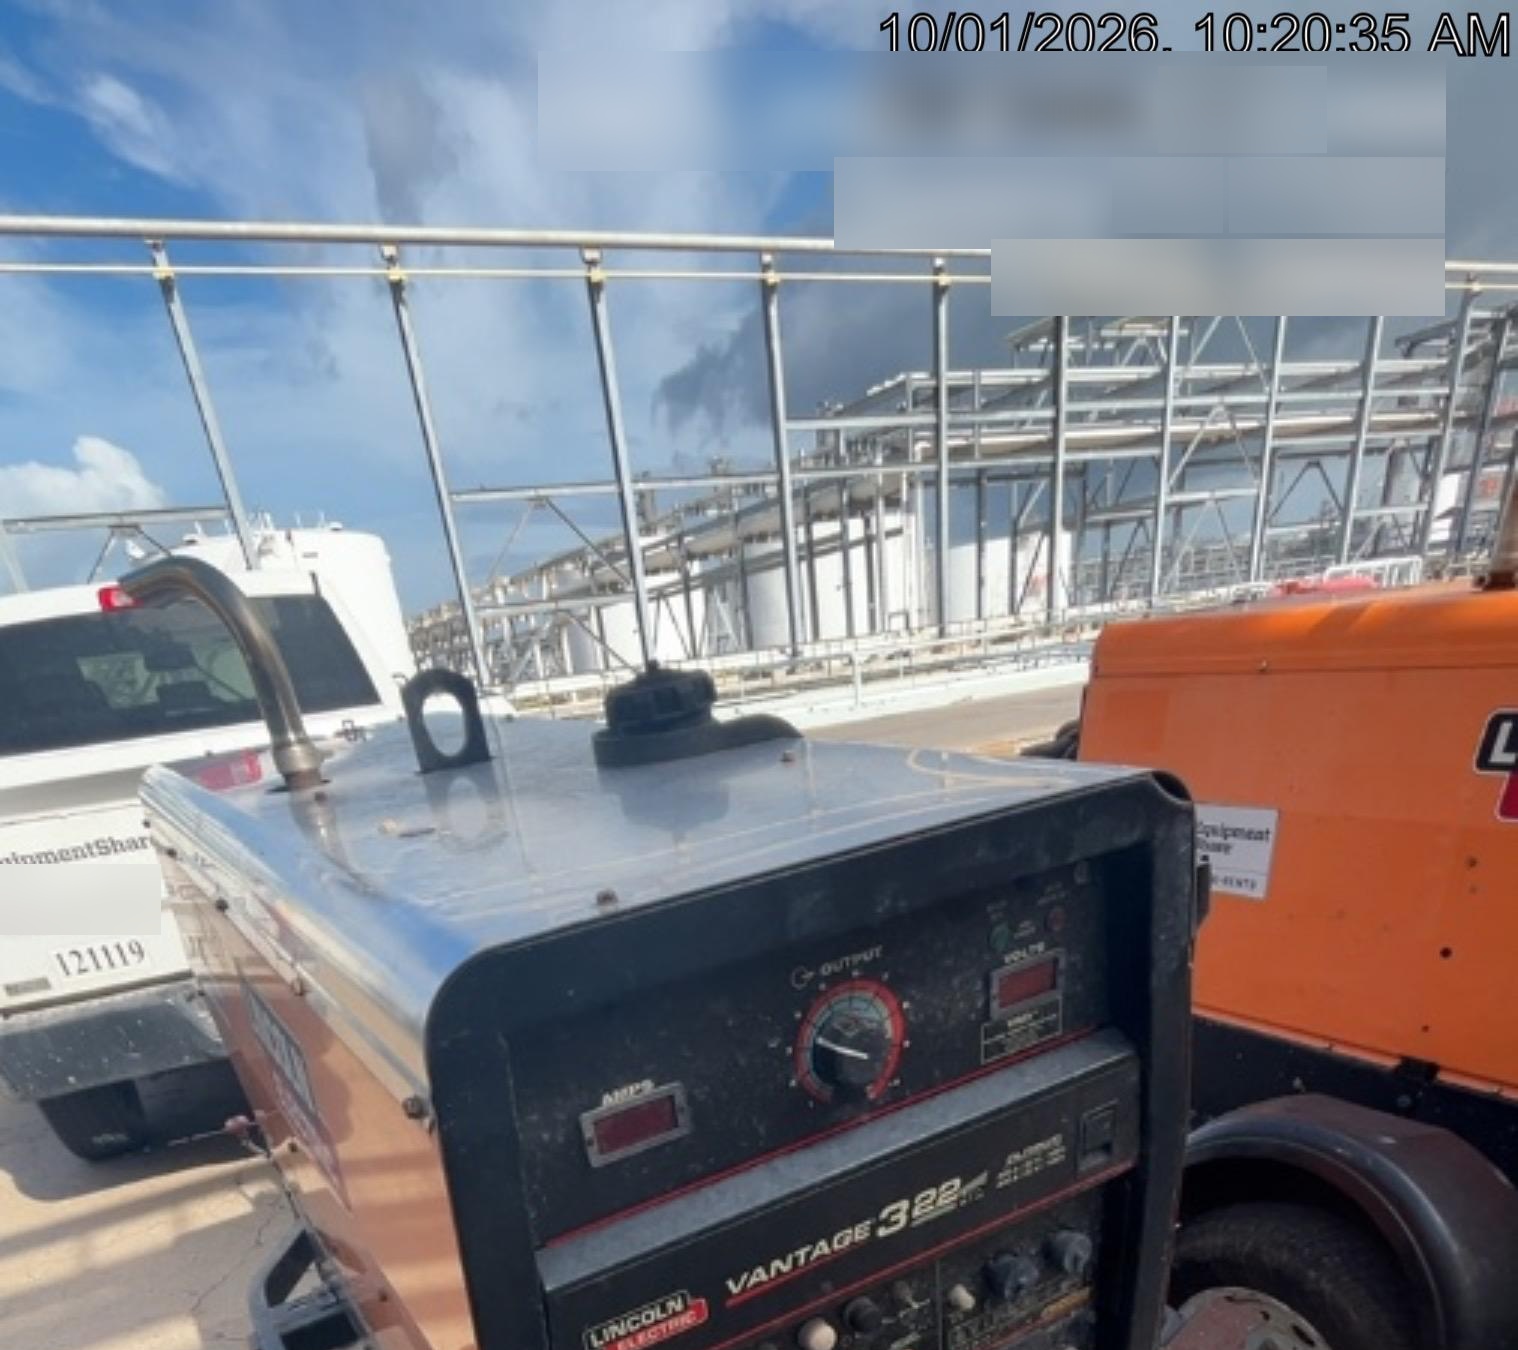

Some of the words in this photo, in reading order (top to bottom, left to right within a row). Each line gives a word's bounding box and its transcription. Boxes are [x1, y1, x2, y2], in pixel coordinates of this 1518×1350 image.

[56, 939, 145, 977] 121119
[819, 946, 883, 976] OUTPUT
[725, 1218, 875, 1295] VANTAGE
[877, 1176, 962, 1238] 322
[590, 1294, 685, 1349] LINCOLN
